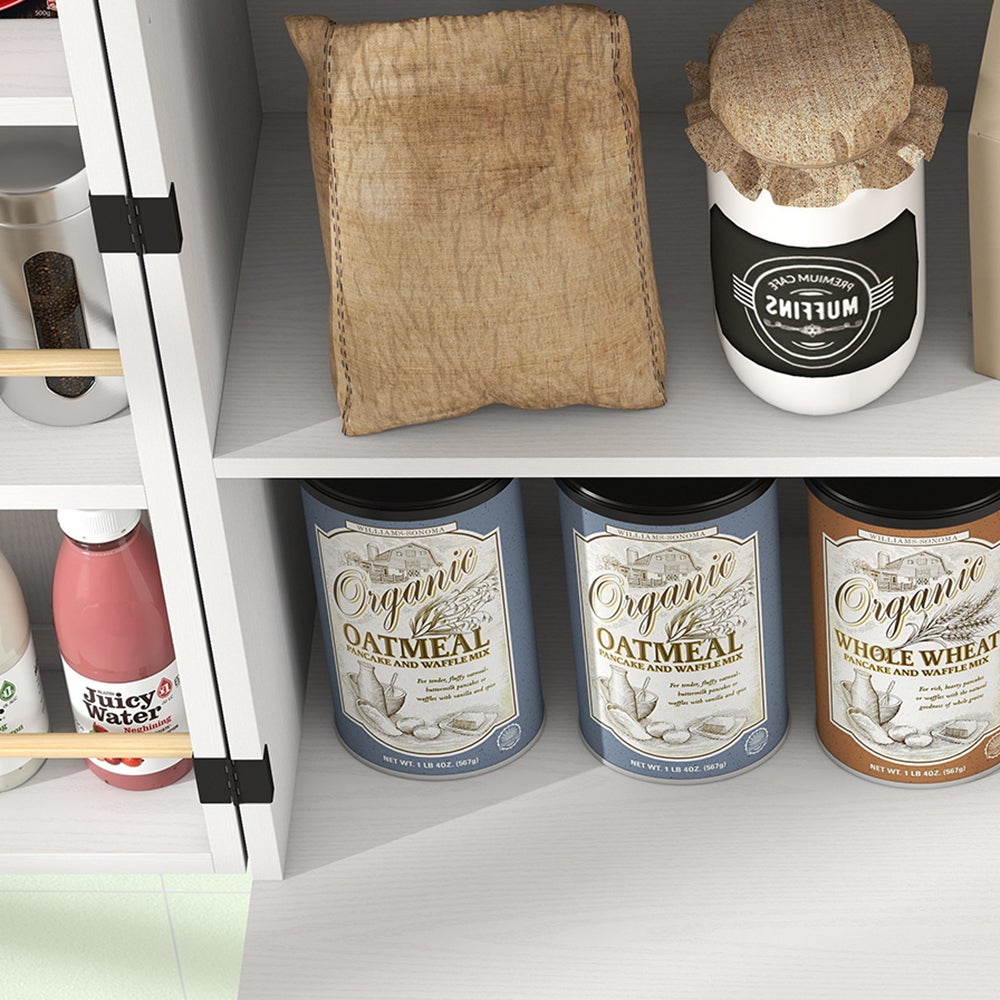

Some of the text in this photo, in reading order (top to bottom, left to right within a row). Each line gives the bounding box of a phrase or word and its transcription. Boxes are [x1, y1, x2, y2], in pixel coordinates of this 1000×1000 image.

[333, 546, 477, 632] Organic
[588, 551, 735, 637] Organic
[835, 553, 987, 641] Organic
[343, 622, 491, 660] OATMEAL
[596, 626, 744, 664] OATMEAL
[834, 627, 1000, 667] WHOLE WHEAT
[346, 644, 490, 669] PANCAKE AND WAFFLE MIX
[599, 648, 743, 673] PANCAKE AND WAFFLE MIX
[843, 653, 989, 677] PANCAKE AND WAFFLE MIX
[83, 687, 156, 710] Juicy
[83, 700, 162, 726] Water
[383, 755, 398, 765] NET
[630, 759, 645, 769] NET
[869, 763, 885, 773] NET
